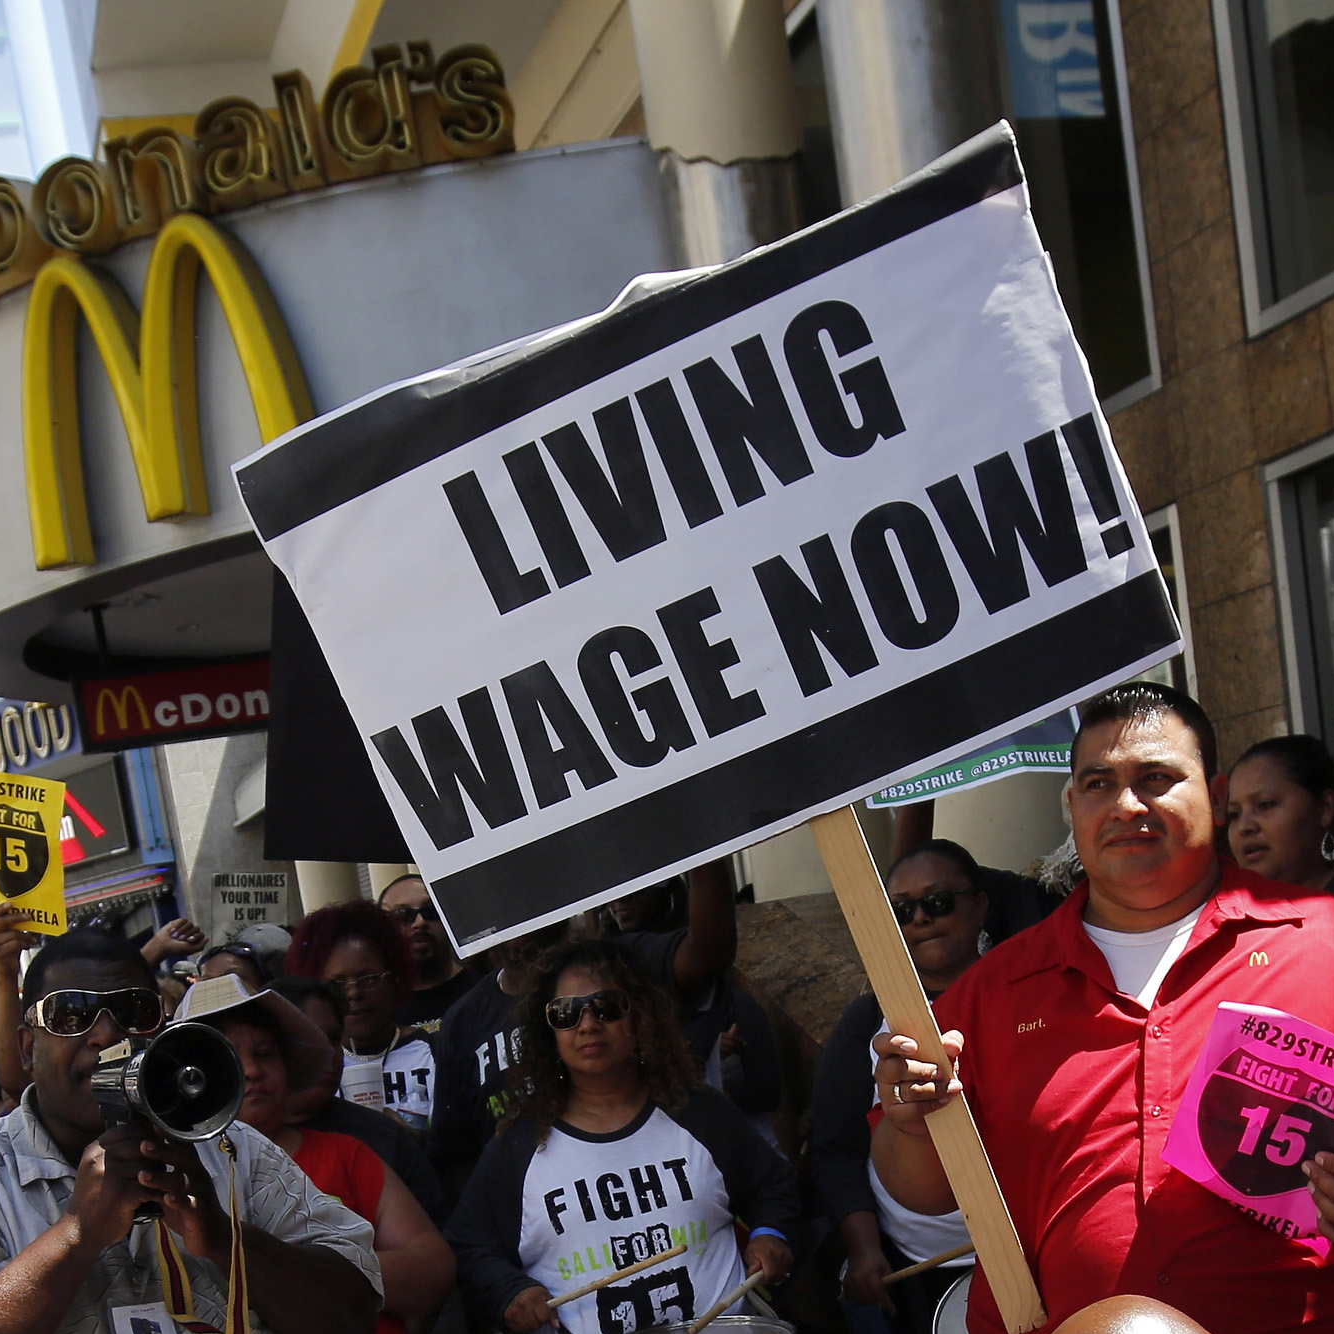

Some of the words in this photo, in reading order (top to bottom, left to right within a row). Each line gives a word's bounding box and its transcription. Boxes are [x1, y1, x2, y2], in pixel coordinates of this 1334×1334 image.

[442, 300, 906, 615] LIVING
[371, 588, 766, 851] WAGE
[752, 412, 1134, 697] NOW!
[879, 769, 964, 800] #829STRIKE
[970, 750, 1071, 778] @829STRIKELA
[12, 811, 36, 830] FOR
[214, 874, 285, 888] BILLIONAIRES
[221, 891, 251, 904] YOUR
[253, 891, 279, 904] TIME
[234, 907, 244, 920] IS
[247, 907, 266, 920] UP!
[1017, 1018, 1046, 1034] Bart.
[1235, 1056, 1299, 1095] FIGHT
[1237, 1105, 1313, 1167] 15
[543, 1157, 694, 1236] FIGHT
